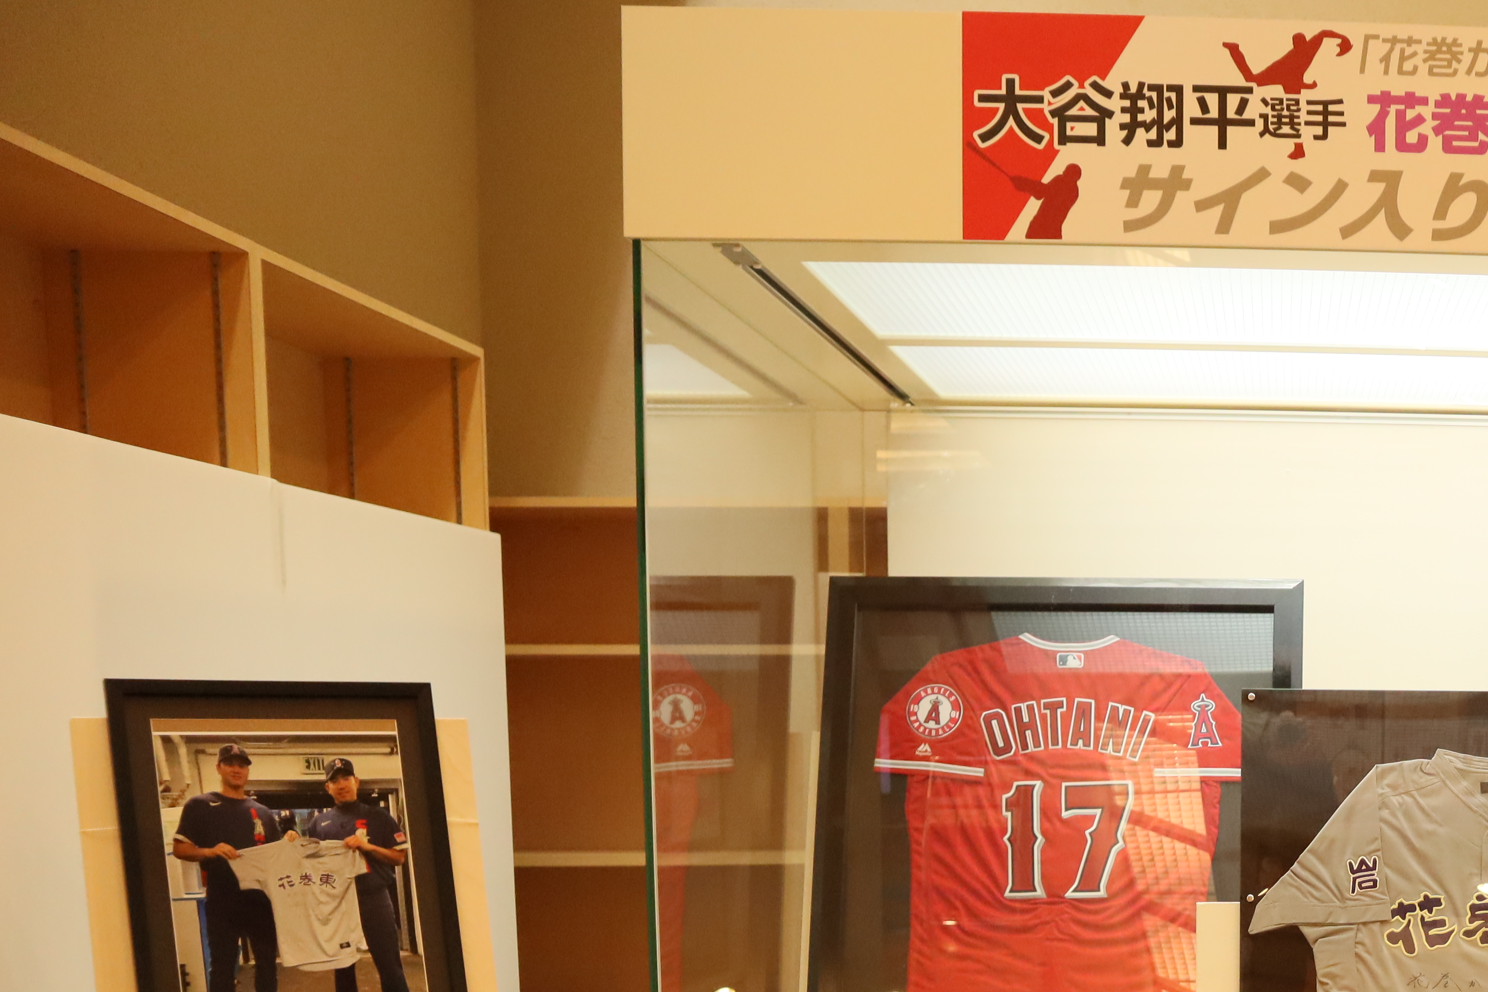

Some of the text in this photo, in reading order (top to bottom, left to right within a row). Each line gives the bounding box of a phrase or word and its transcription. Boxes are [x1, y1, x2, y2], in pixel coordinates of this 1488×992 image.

[975, 75, 1347, 151] 大谷翔平選手
[980, 697, 1156, 761] OHTANI
[1002, 780, 1135, 899] 17
[278, 872, 337, 890] 花巻東
[1347, 856, 1379, 895] 岩
